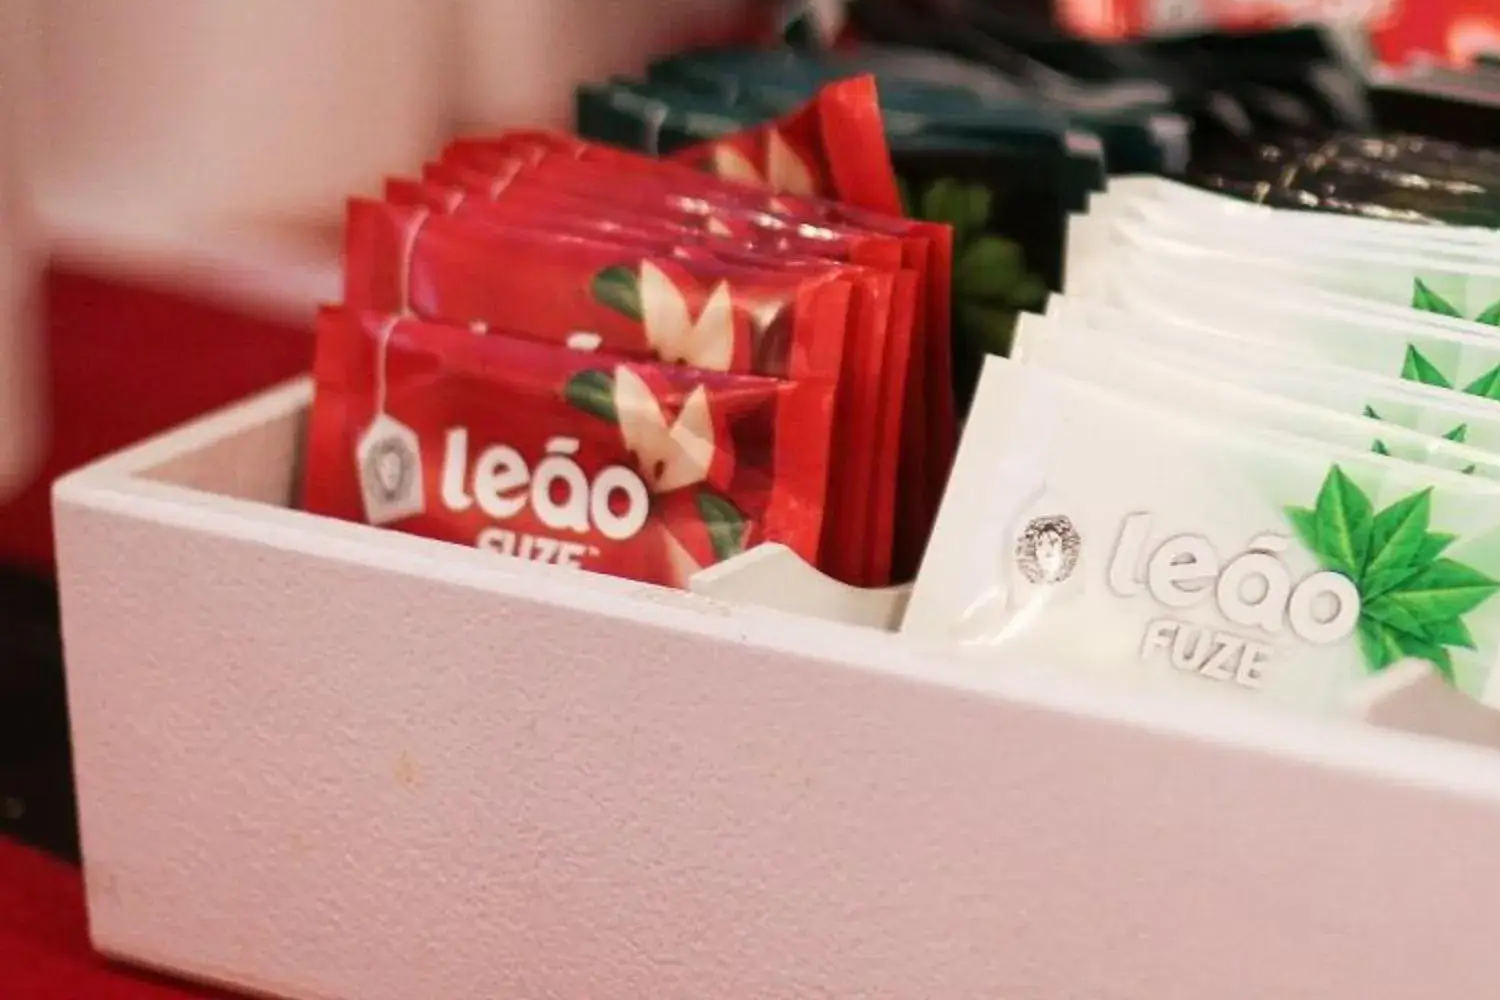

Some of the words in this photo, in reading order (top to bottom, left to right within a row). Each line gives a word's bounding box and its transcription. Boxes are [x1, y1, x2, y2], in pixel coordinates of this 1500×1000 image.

[442, 426, 649, 541] leão
[1107, 510, 1361, 645] leão
[1141, 615, 1274, 688] FUZE
